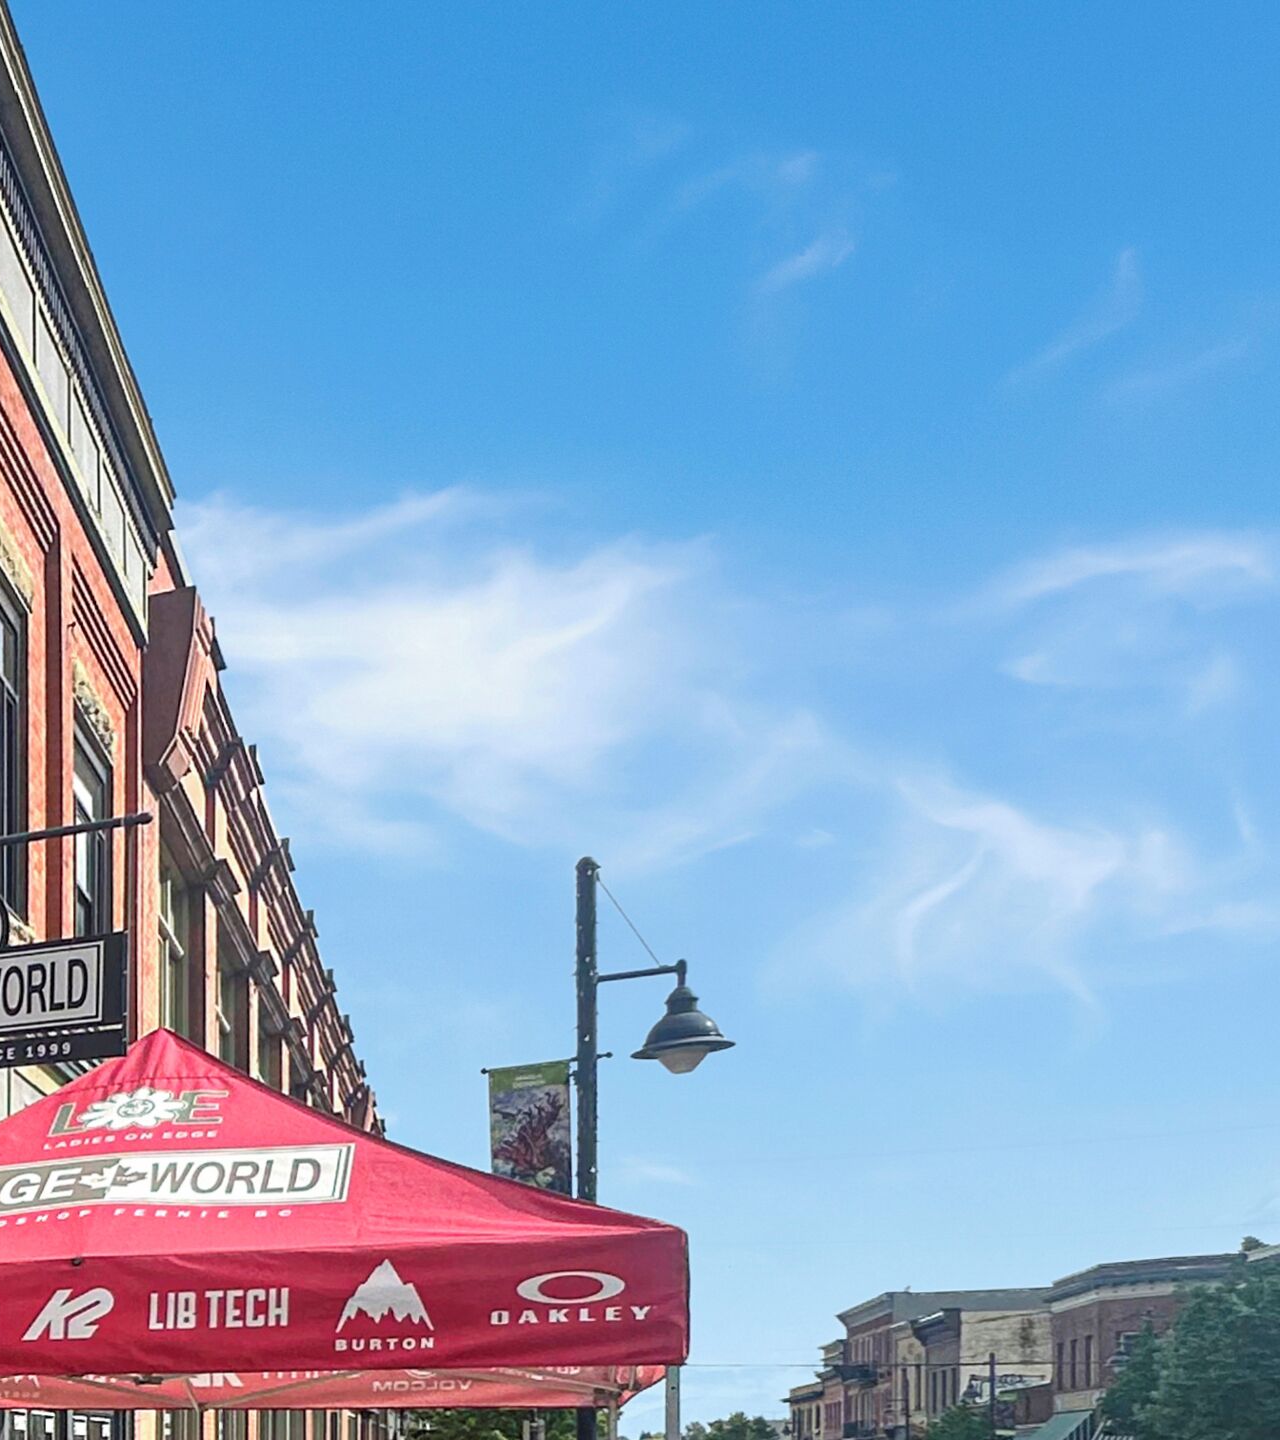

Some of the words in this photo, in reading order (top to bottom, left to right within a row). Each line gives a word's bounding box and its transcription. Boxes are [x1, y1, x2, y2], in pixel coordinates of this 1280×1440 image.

[26, 1042, 72, 1059] 1999
[43, 1134, 116, 1150] LADIES
[124, 1131, 153, 1142] ON
[161, 1129, 219, 1140] EDGE
[150, 1157, 322, 1194] WORLD
[113, 1208, 230, 1219] FERNIE
[254, 1209, 293, 1218] BC
[21, 1287, 115, 1342] K2
[148, 1290, 197, 1331] LIB
[206, 1287, 290, 1329] TECH
[490, 1304, 651, 1326] OAKLEY
[335, 1336, 435, 1352] BURTON
